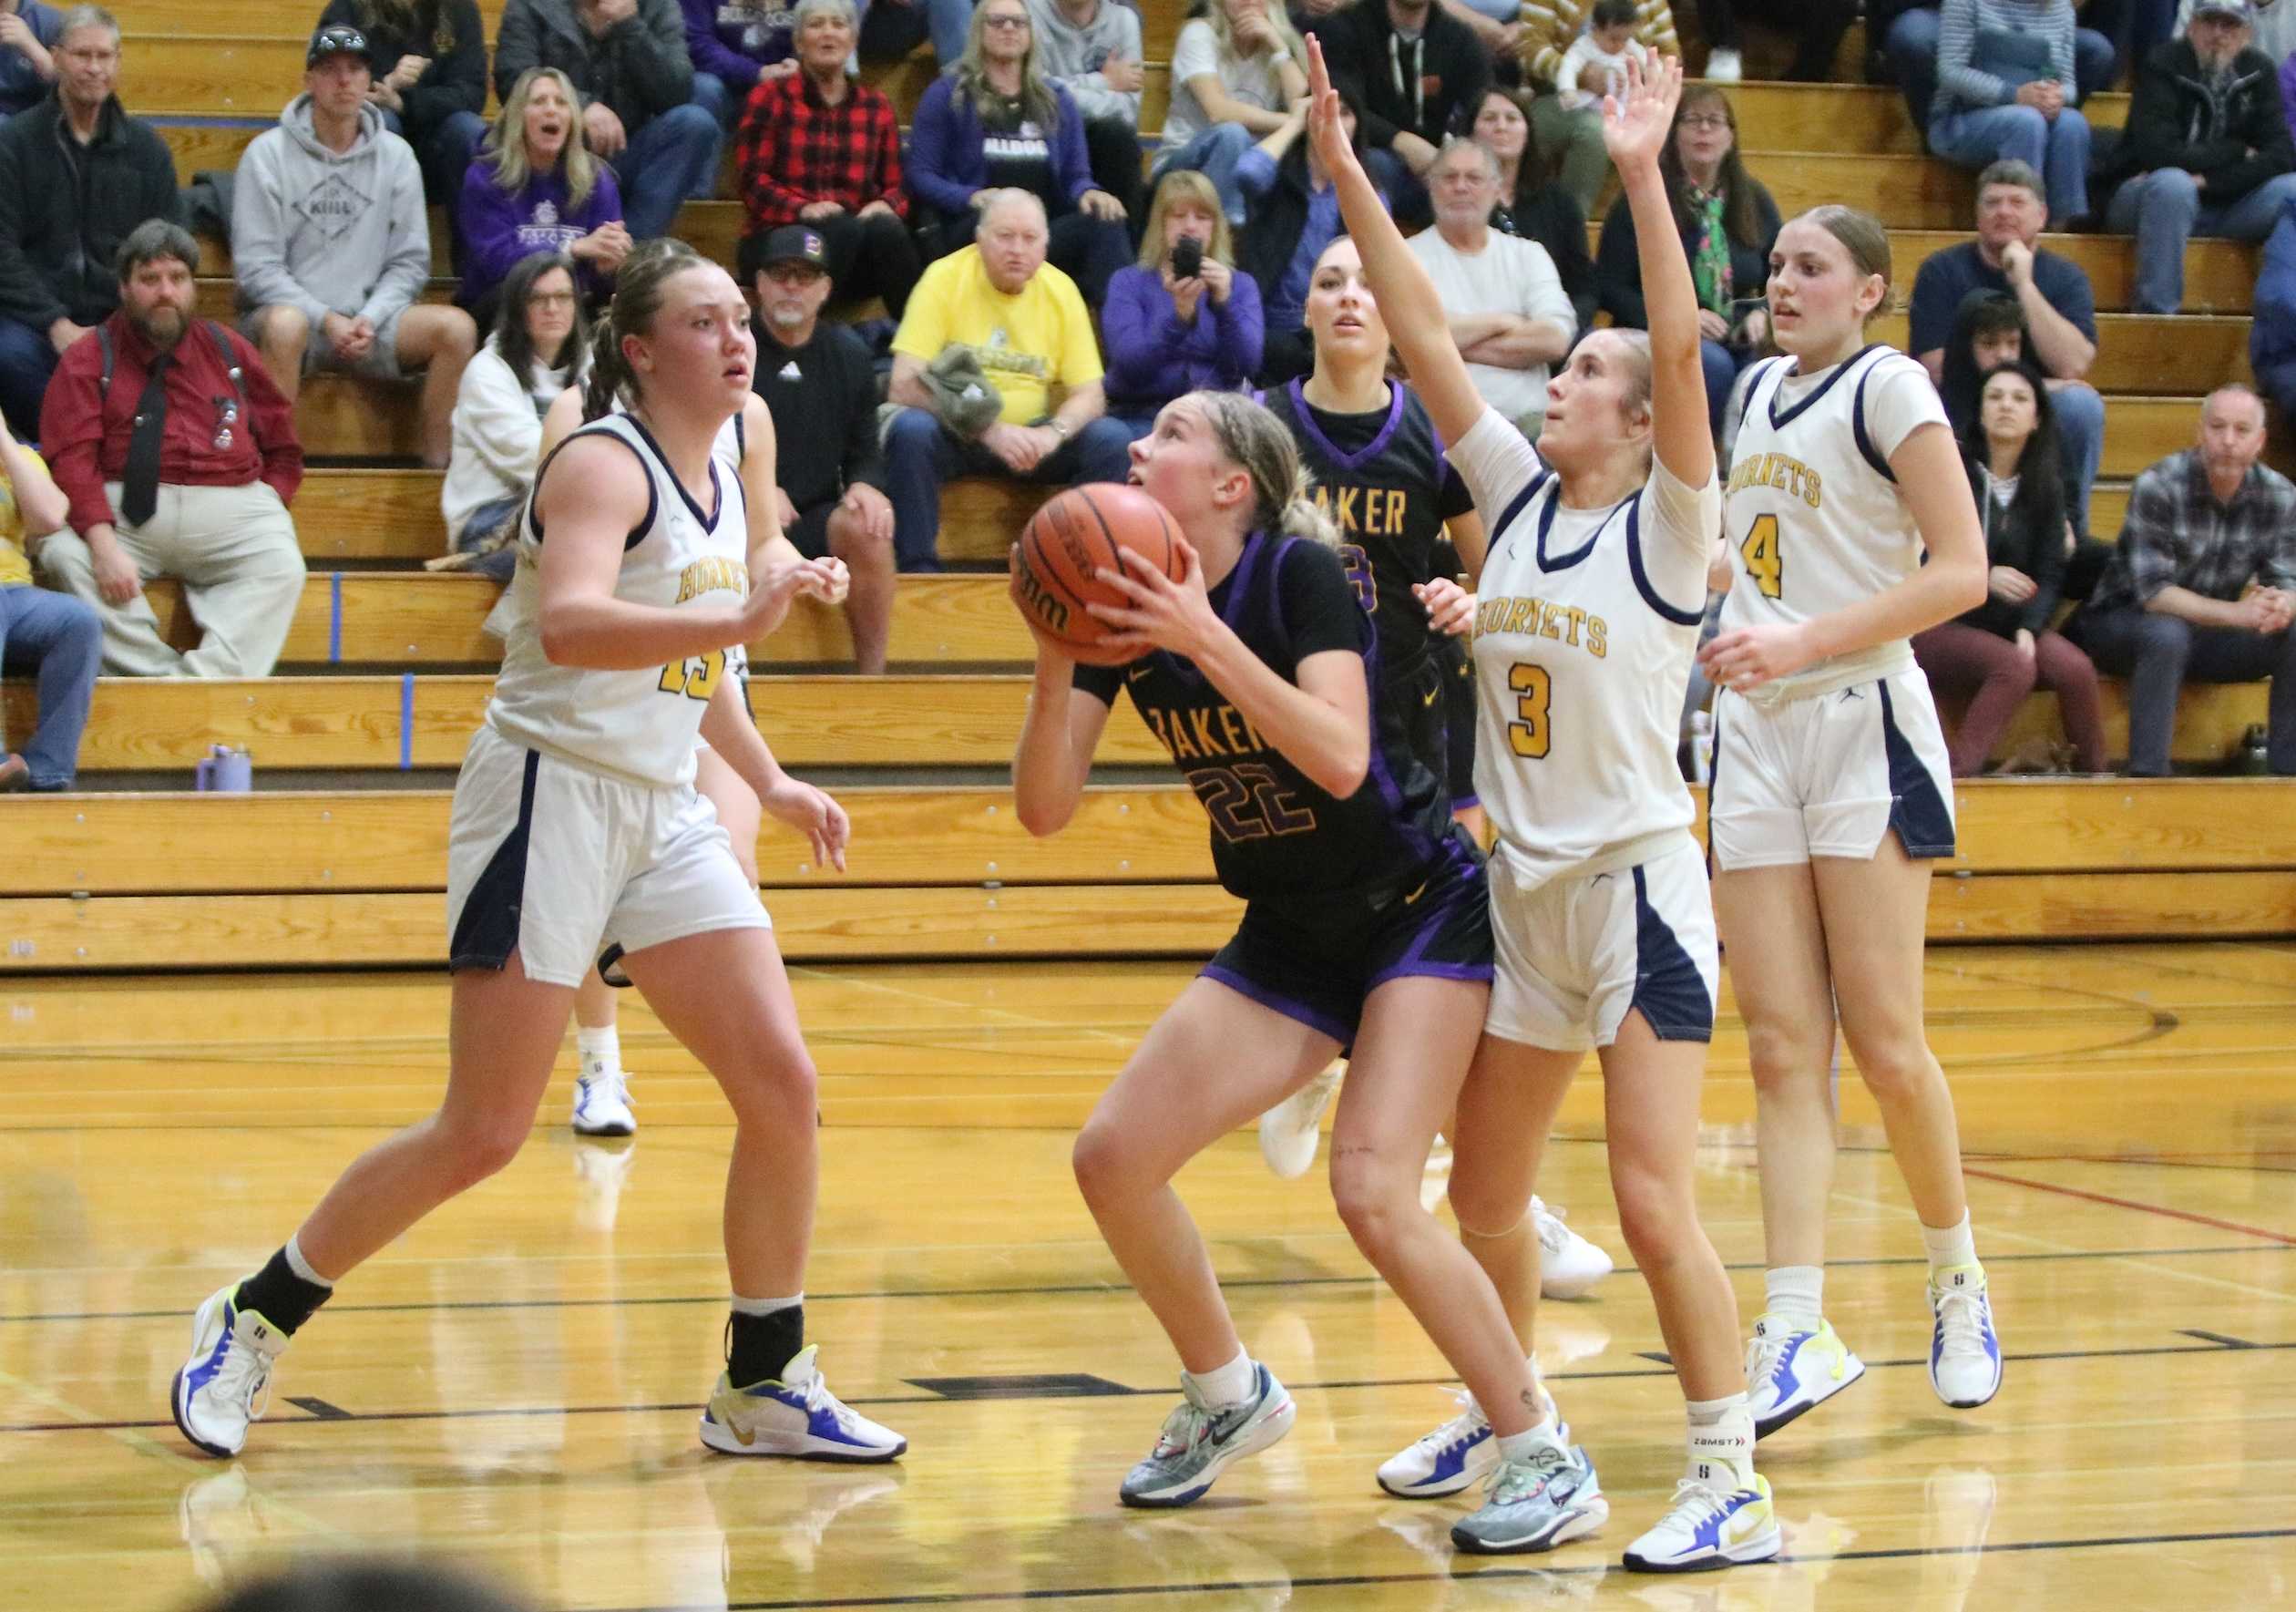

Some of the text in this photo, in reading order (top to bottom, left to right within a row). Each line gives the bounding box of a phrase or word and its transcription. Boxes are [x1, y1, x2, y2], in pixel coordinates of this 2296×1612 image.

[1297, 485, 1406, 534] AKER
[1725, 452, 1821, 508] ORNETS
[1740, 513, 1782, 600] 4
[1508, 662, 1551, 759] 3
[1187, 764, 1317, 843] 22
